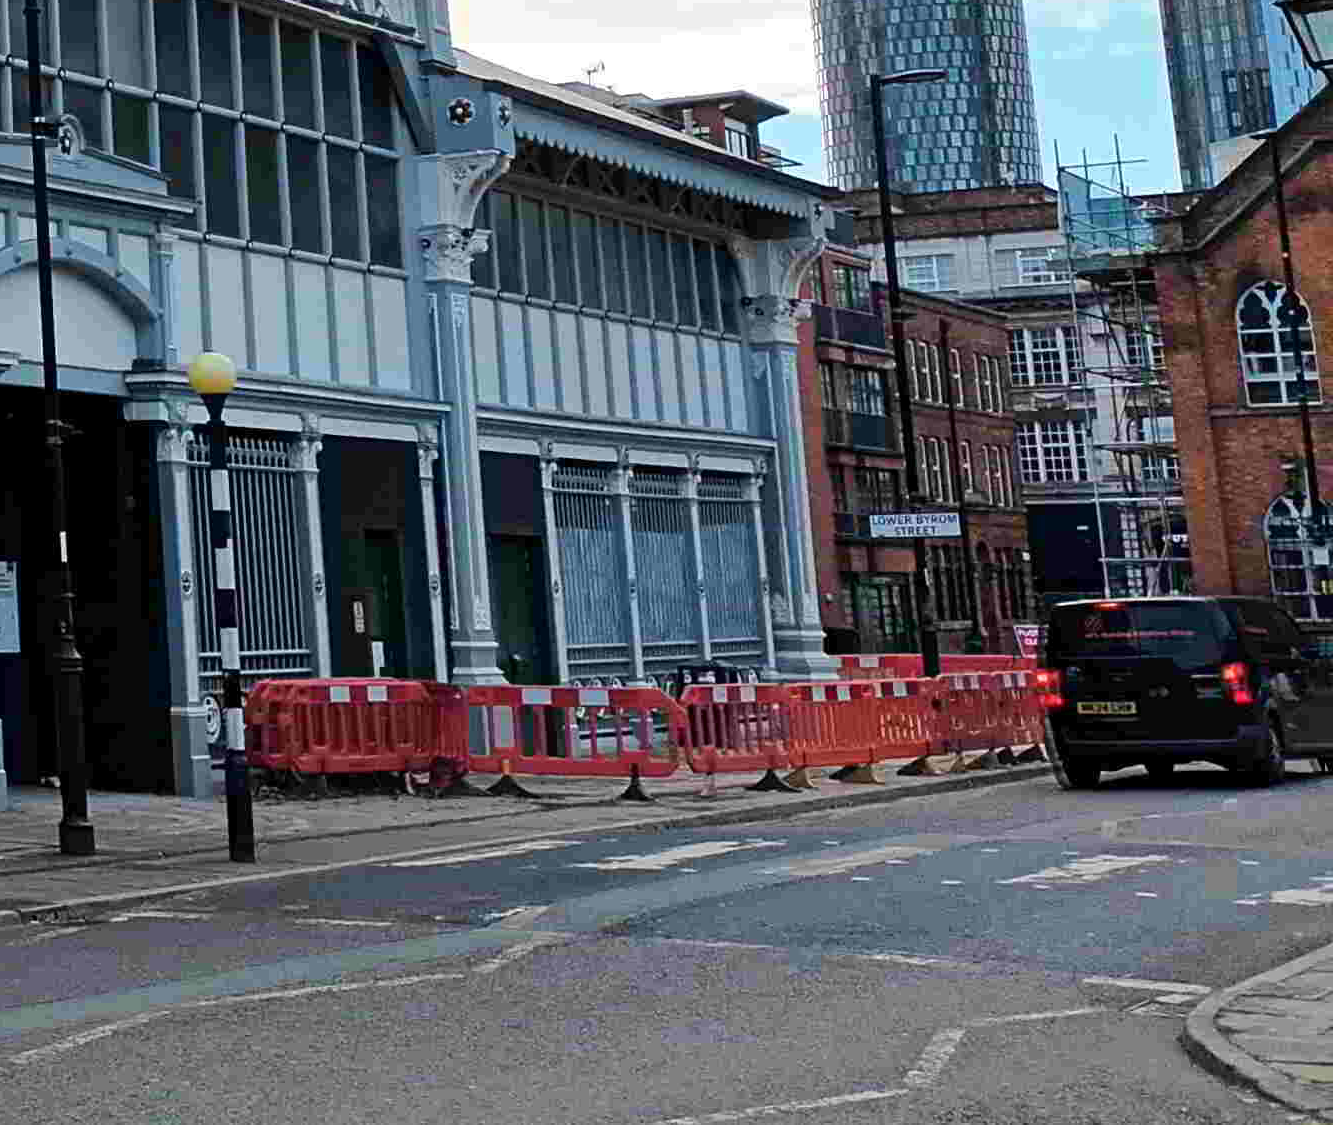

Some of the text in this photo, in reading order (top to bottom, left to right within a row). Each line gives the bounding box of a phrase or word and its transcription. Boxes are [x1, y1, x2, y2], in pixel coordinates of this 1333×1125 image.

[873, 513, 958, 525] LOWER BYROM
[894, 525, 937, 536] STREET
